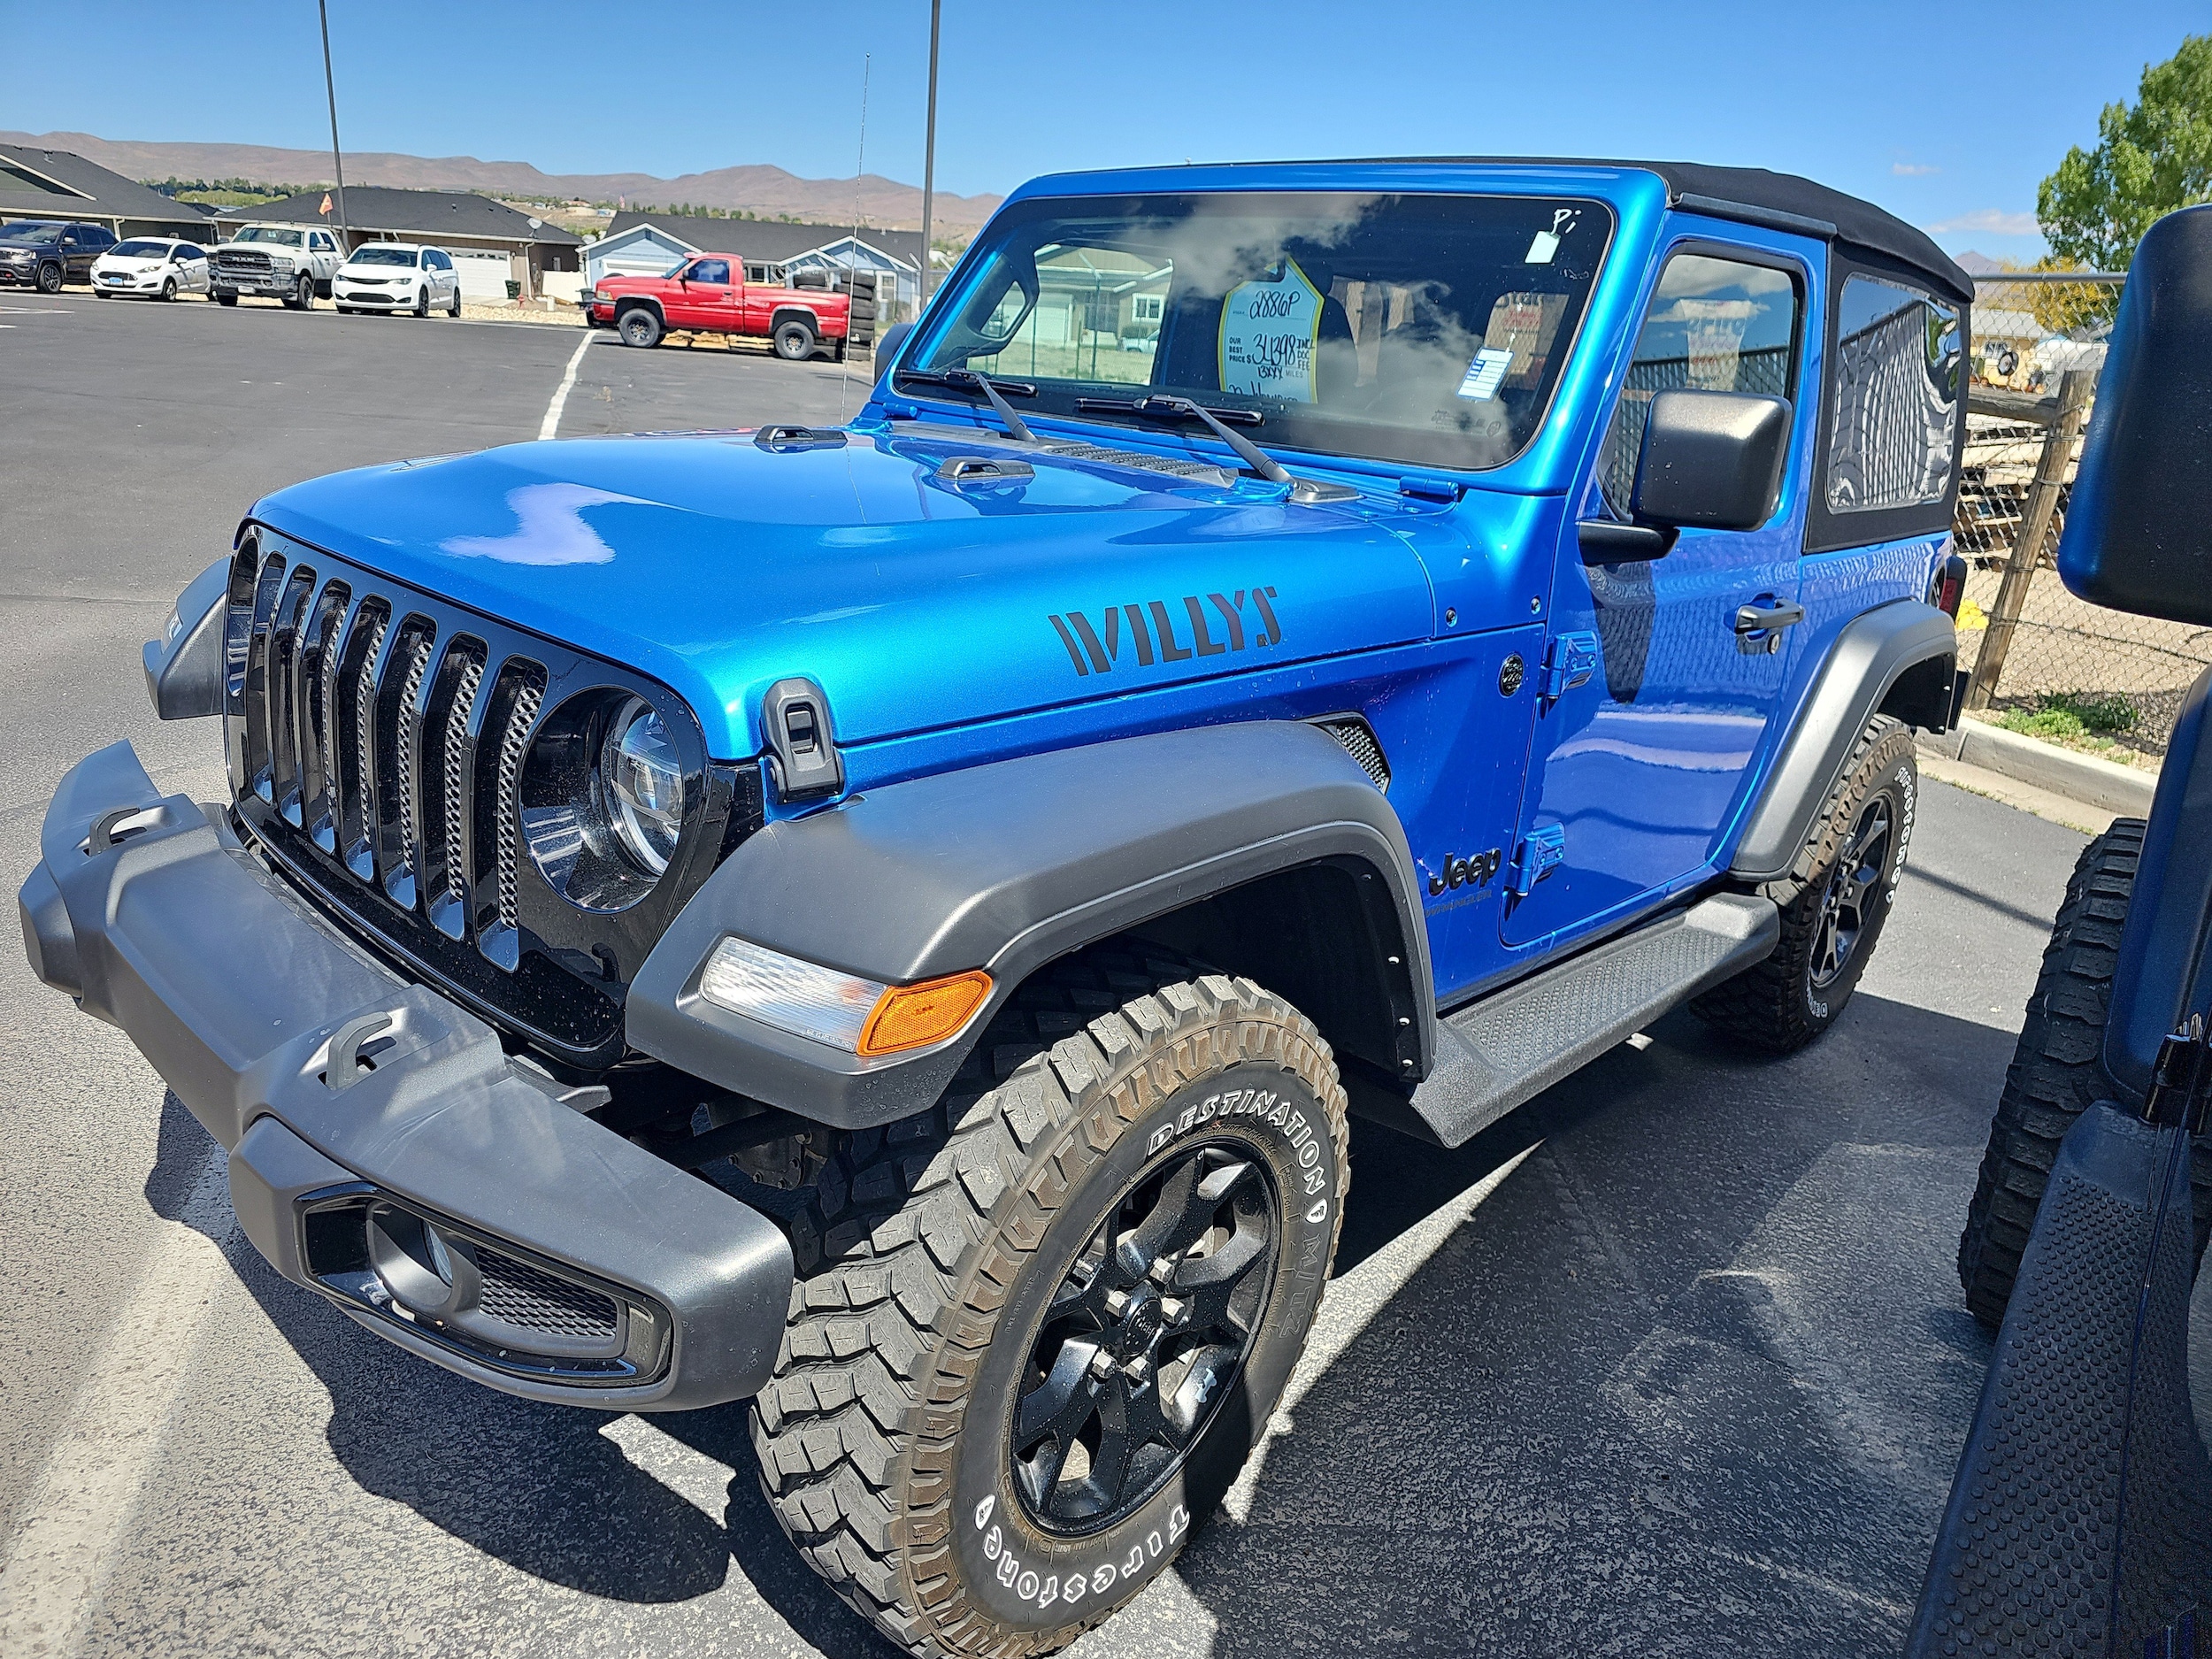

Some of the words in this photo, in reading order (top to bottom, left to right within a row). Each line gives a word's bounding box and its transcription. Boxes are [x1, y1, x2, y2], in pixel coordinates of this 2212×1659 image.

[1228, 354, 1246, 364] PRICE
[1285, 370, 1303, 379] MILES
[1048, 587, 1282, 676] WILLYS
[1428, 847, 1502, 896] Jeep
[1148, 1089, 1326, 1195] DESTINATION
[983, 1503, 1191, 1609] Firestone
